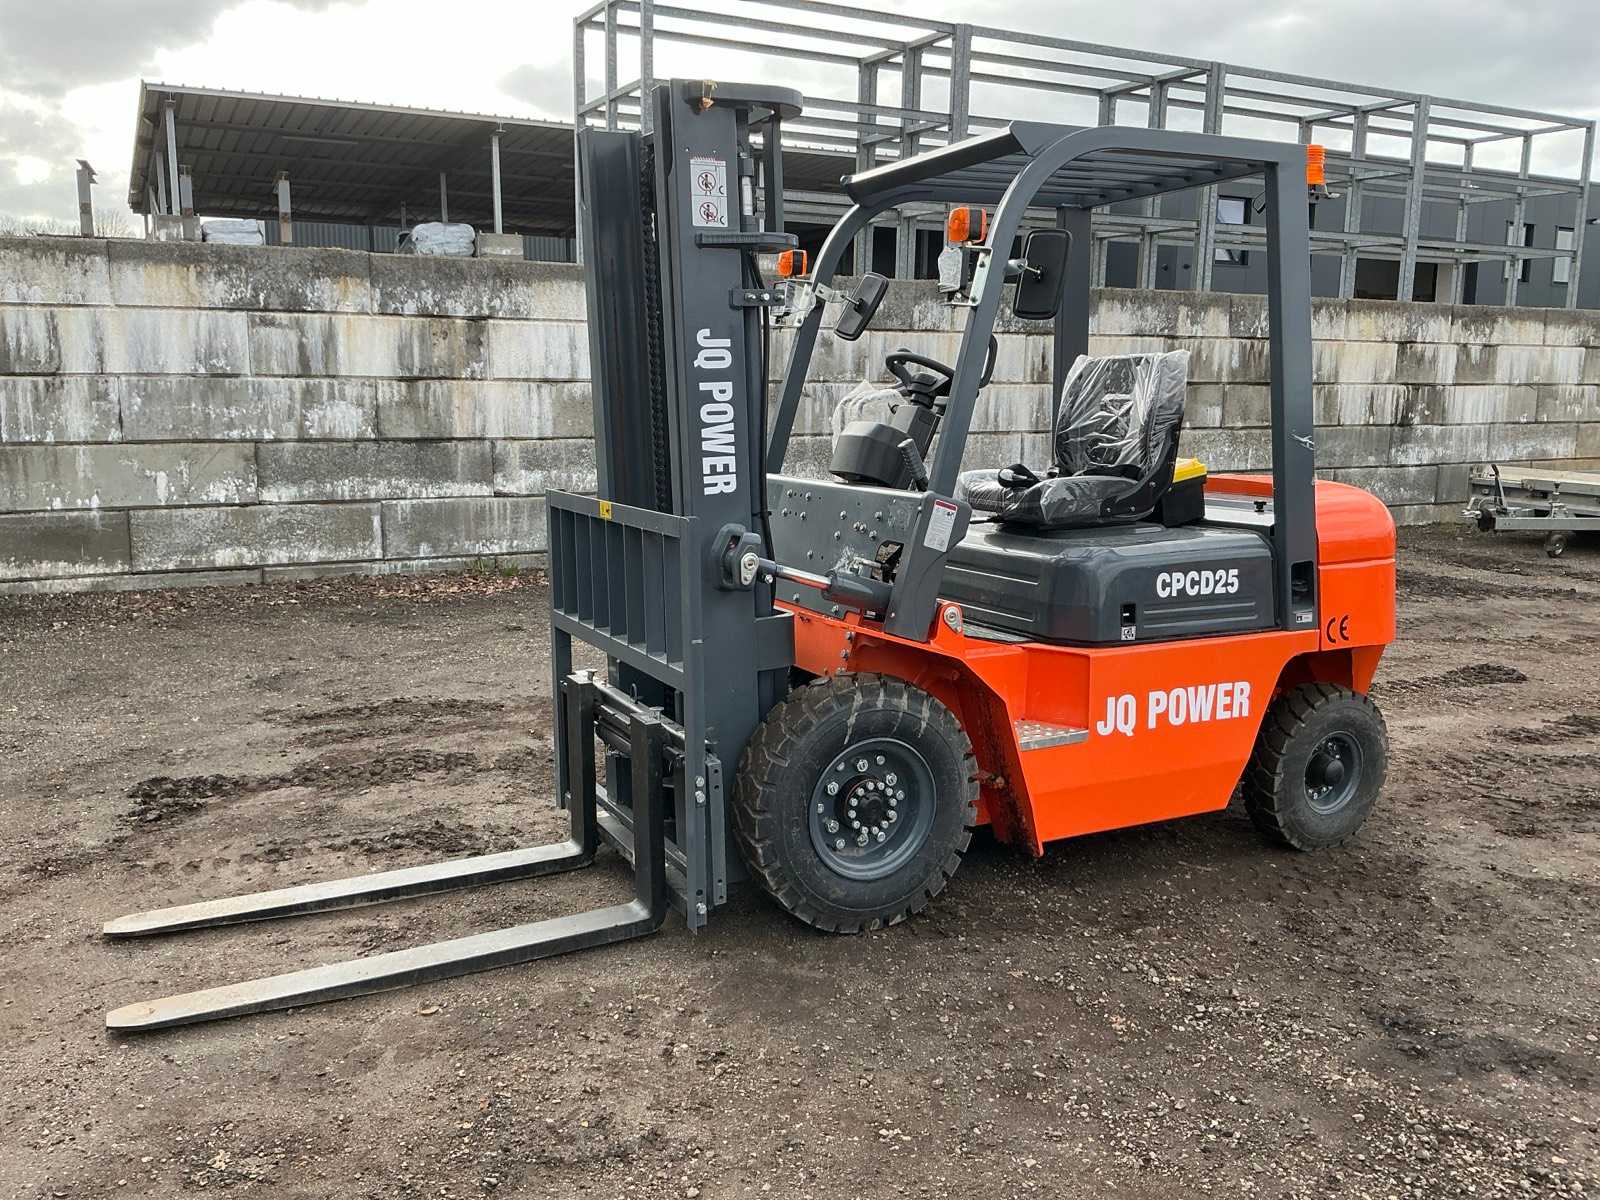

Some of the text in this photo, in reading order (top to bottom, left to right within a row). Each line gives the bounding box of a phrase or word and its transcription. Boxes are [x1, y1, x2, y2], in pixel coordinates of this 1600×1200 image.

[693, 328, 737, 496] JQ POWER
[1156, 569, 1240, 598] CPCD25
[1326, 615, 1350, 644] CE
[1096, 681, 1251, 737] JQ POWER
